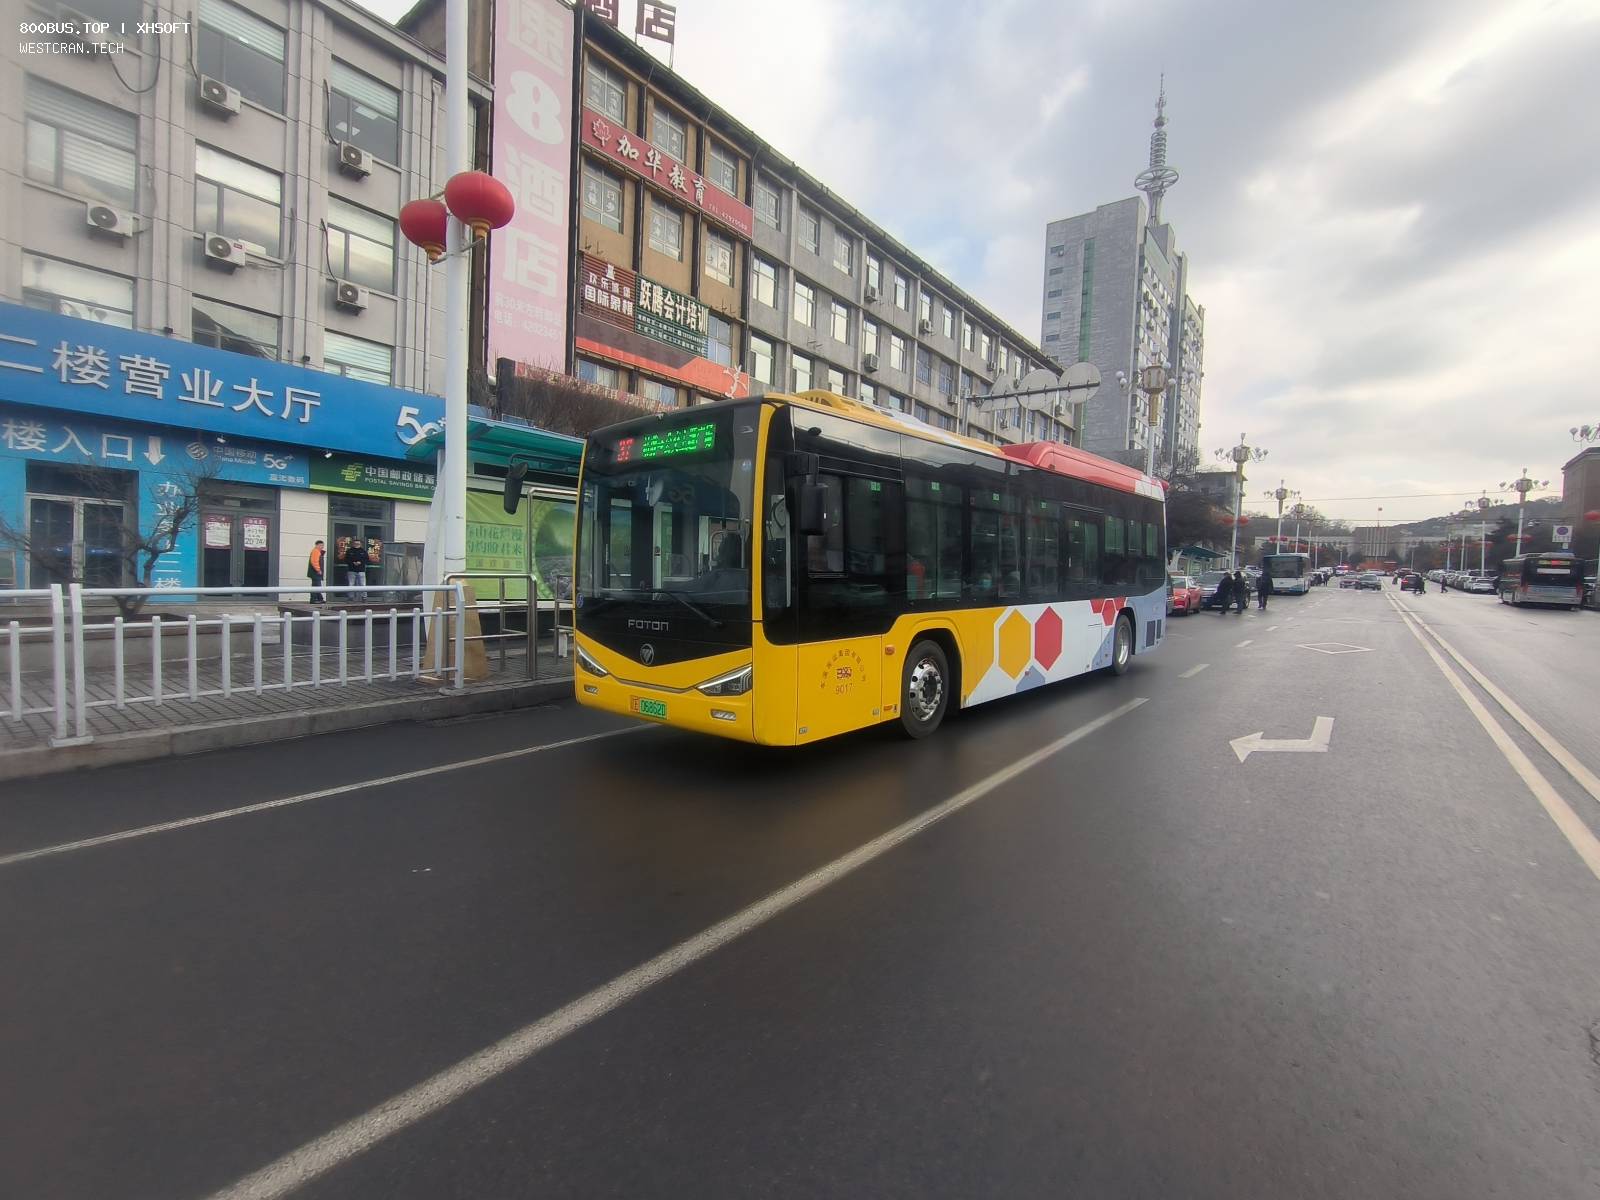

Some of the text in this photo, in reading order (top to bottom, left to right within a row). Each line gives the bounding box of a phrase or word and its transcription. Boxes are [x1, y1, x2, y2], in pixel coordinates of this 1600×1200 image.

[616, 135, 708, 206] 加华教育
[584, 284, 633, 316] 国际象棋
[639, 278, 709, 336] 跃腾会计培训
[0, 333, 321, 423] 二楼营业大厅
[2, 418, 133, 461] 楼入口
[213, 446, 257, 460] 中国移动
[364, 477, 387, 485] POSTAL
[388, 480, 413, 488] SAVINGS
[628, 619, 669, 631] FOTON
